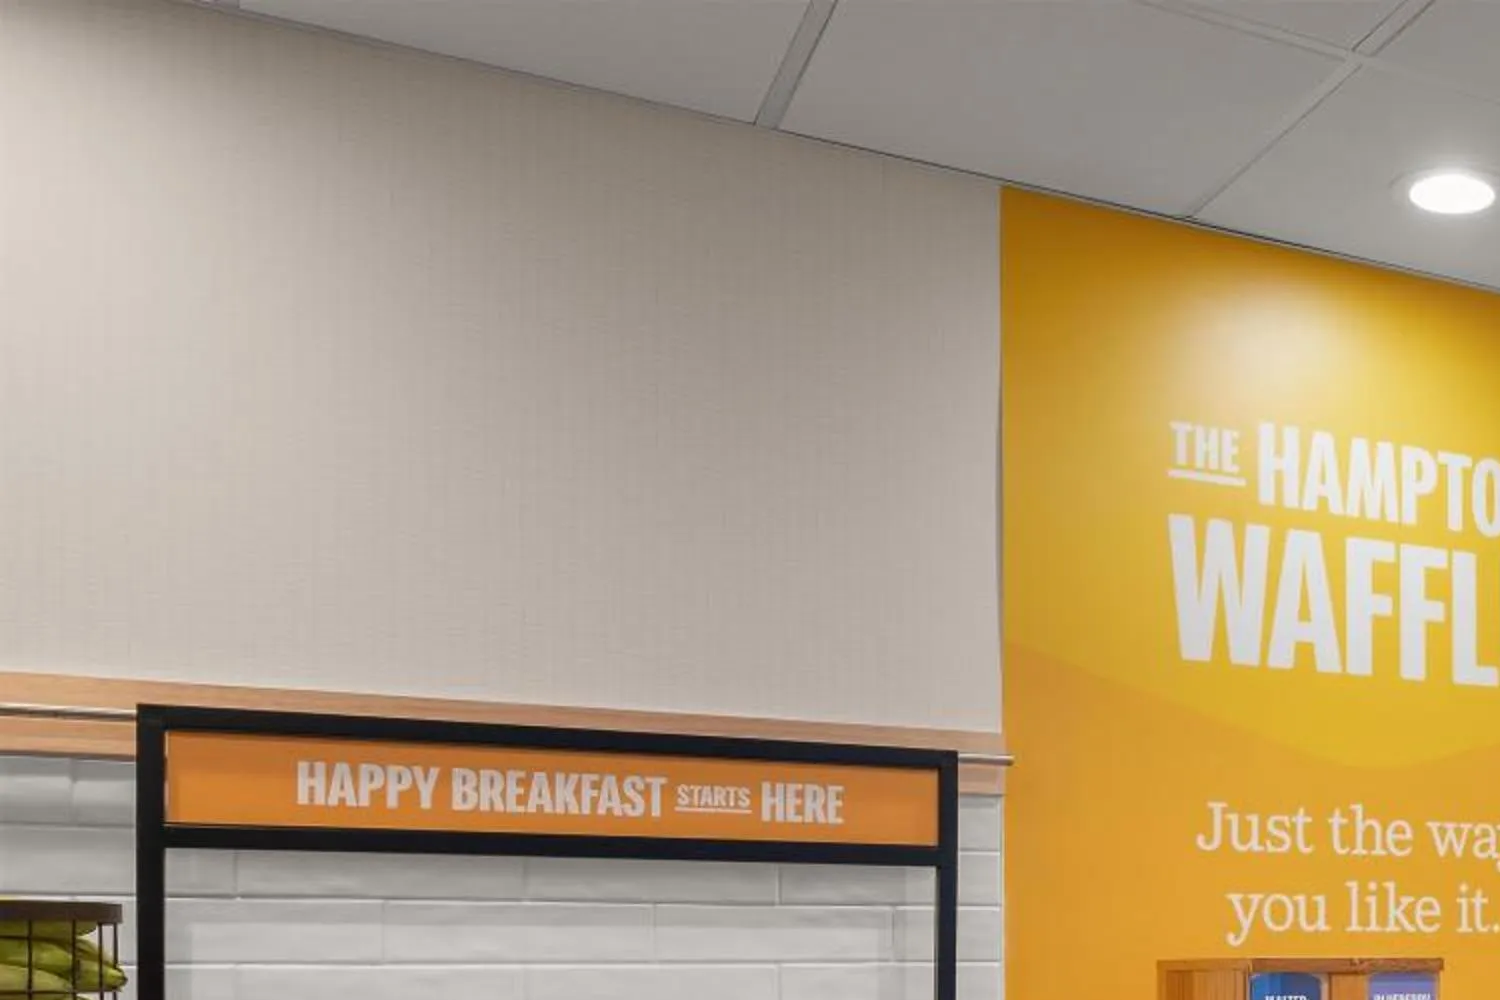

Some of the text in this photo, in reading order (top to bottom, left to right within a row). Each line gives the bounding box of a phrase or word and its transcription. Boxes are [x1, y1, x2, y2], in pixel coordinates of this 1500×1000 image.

[1169, 420, 1240, 474] THE
[297, 761, 845, 825] HAPPY BREAKFAST STARTS HERE
[1196, 801, 1316, 857] Just
[1328, 804, 1414, 857] the
[1225, 892, 1332, 947] you
[1345, 880, 1442, 934] like
